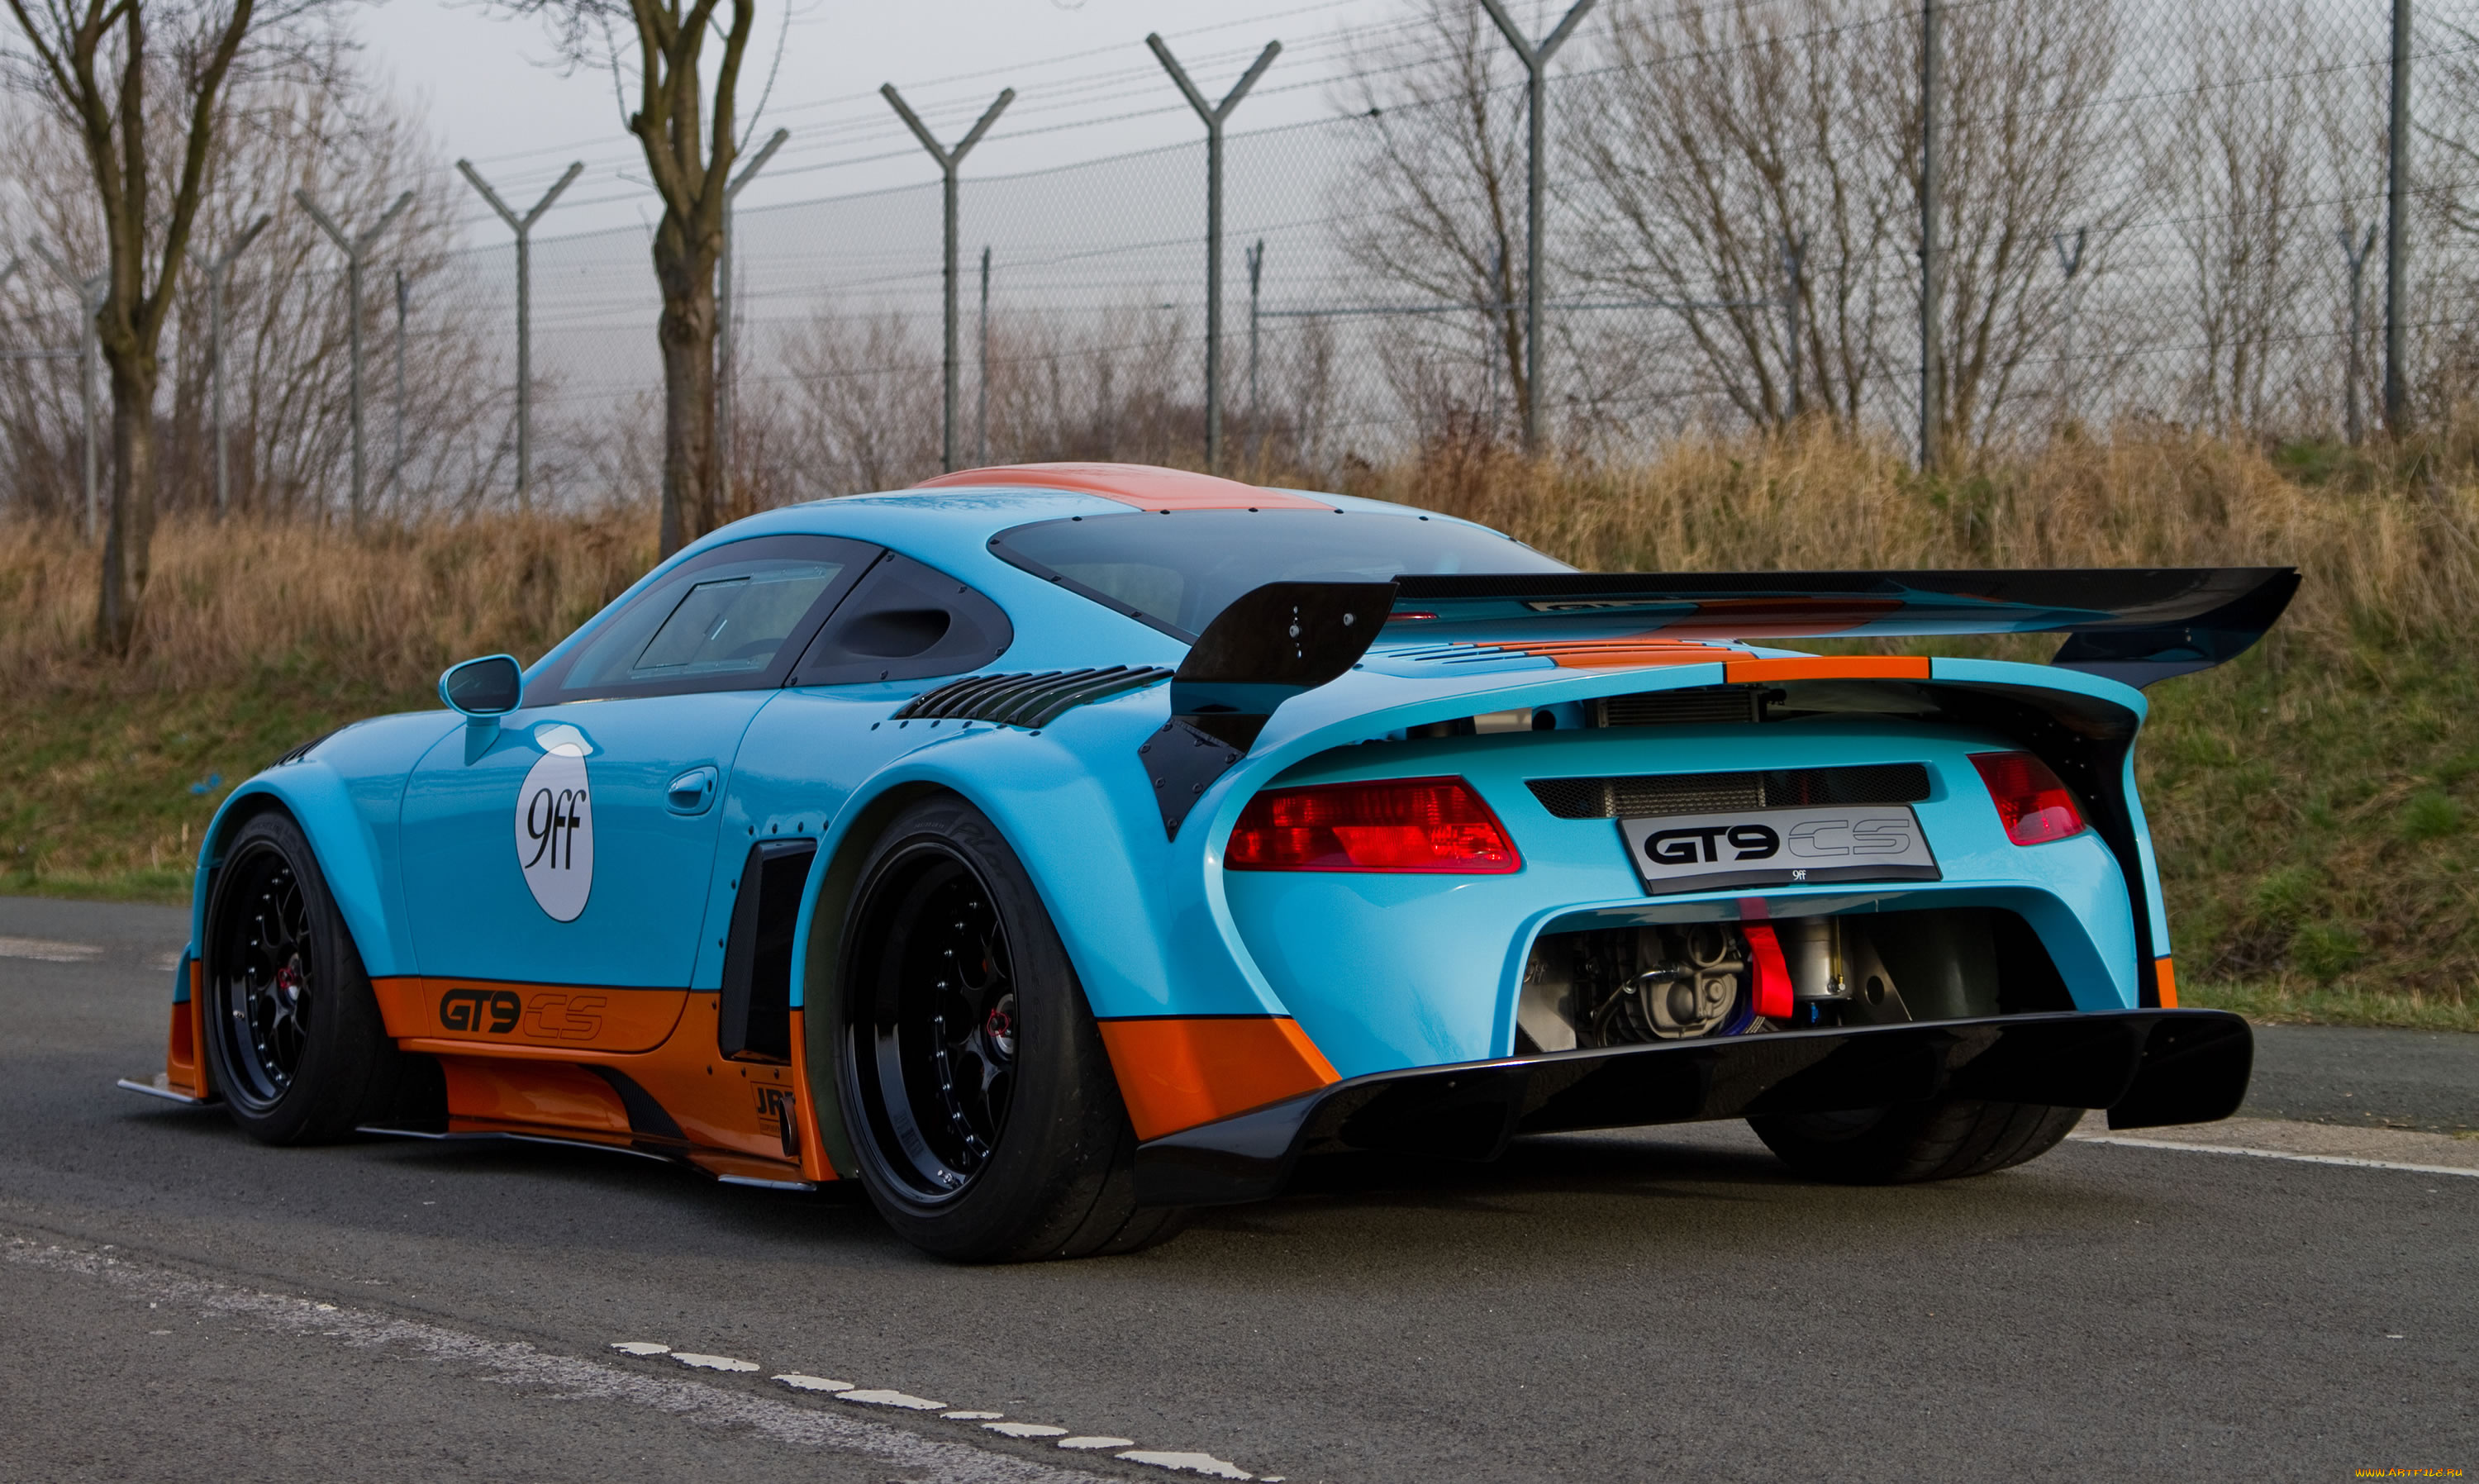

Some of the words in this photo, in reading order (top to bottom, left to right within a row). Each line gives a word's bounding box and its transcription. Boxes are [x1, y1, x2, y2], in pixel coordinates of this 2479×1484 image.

[524, 787, 587, 870] 9ff
[1644, 824, 1780, 865] GT9
[1788, 819, 1910, 858] CS
[1792, 869, 1806, 881] 9ff
[440, 988, 521, 1034] GT9
[523, 993, 607, 1041] CS
